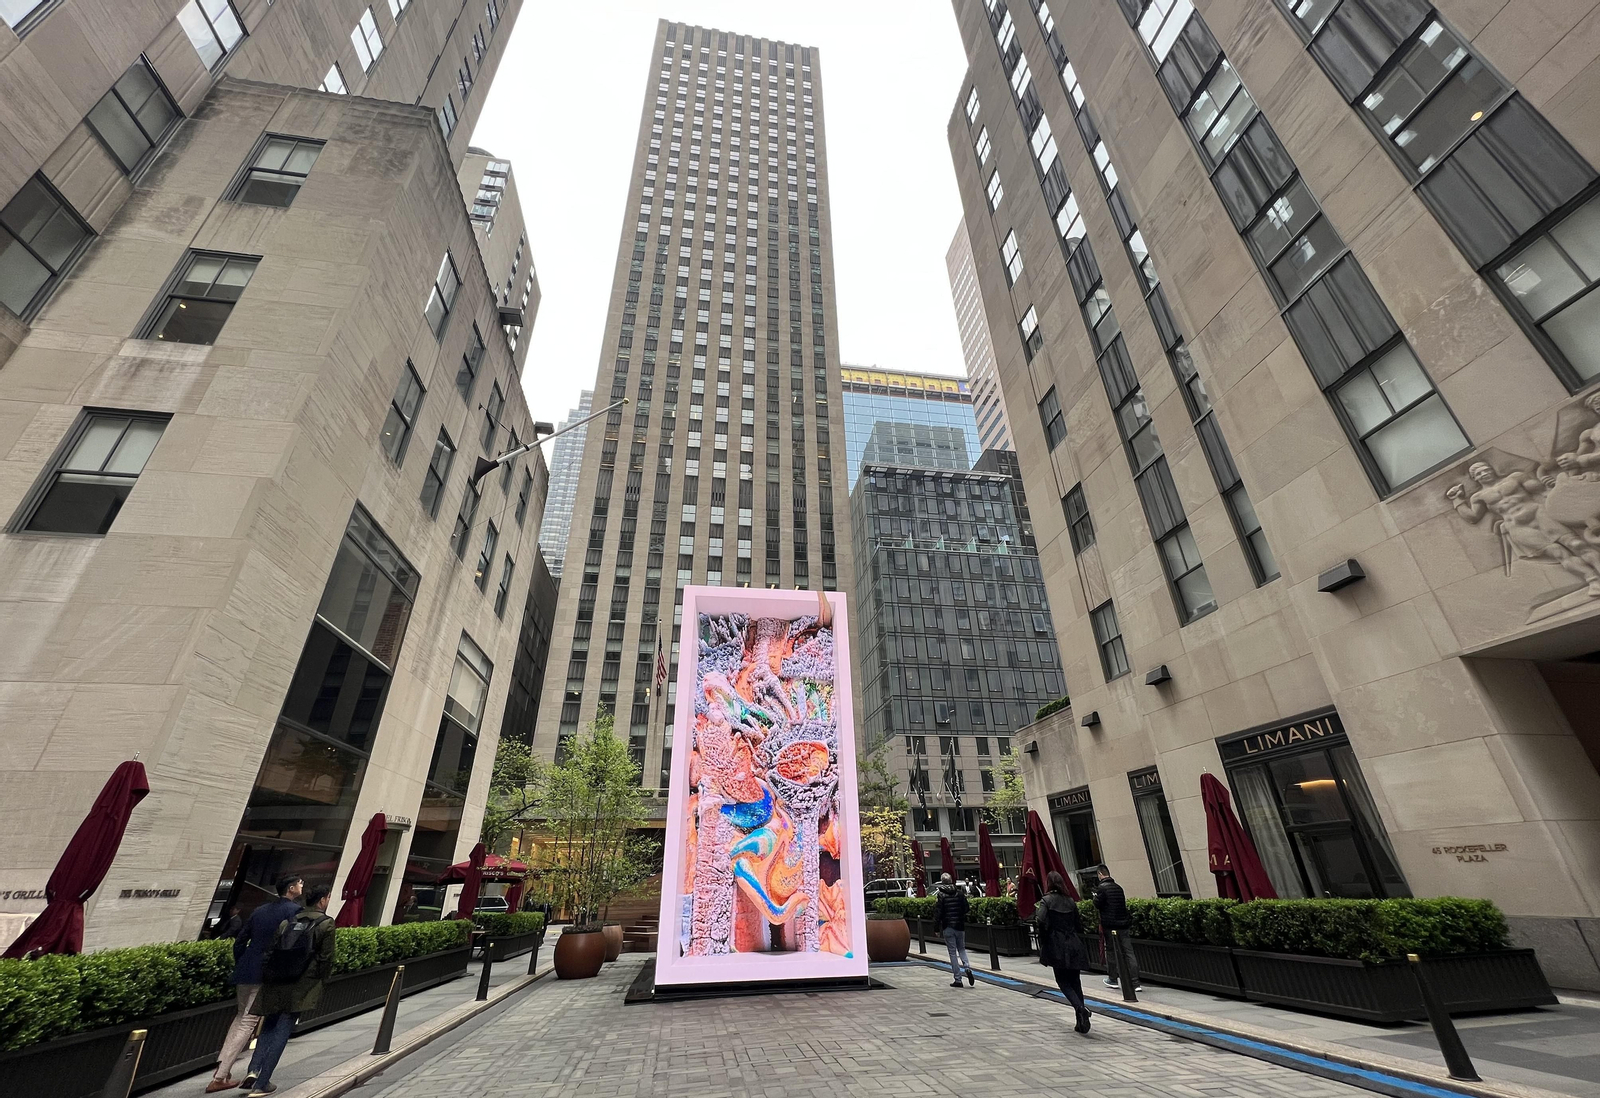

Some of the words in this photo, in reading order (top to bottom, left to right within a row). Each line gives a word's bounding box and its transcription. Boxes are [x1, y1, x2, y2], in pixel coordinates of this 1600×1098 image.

[1243, 718, 1334, 754] LIMANI
[1054, 792, 1089, 808] LIMANI
[1432, 847, 1442, 855] 45
[1443, 843, 1509, 854] ROCKEFELLER
[1456, 854, 1489, 863] PLAZA
